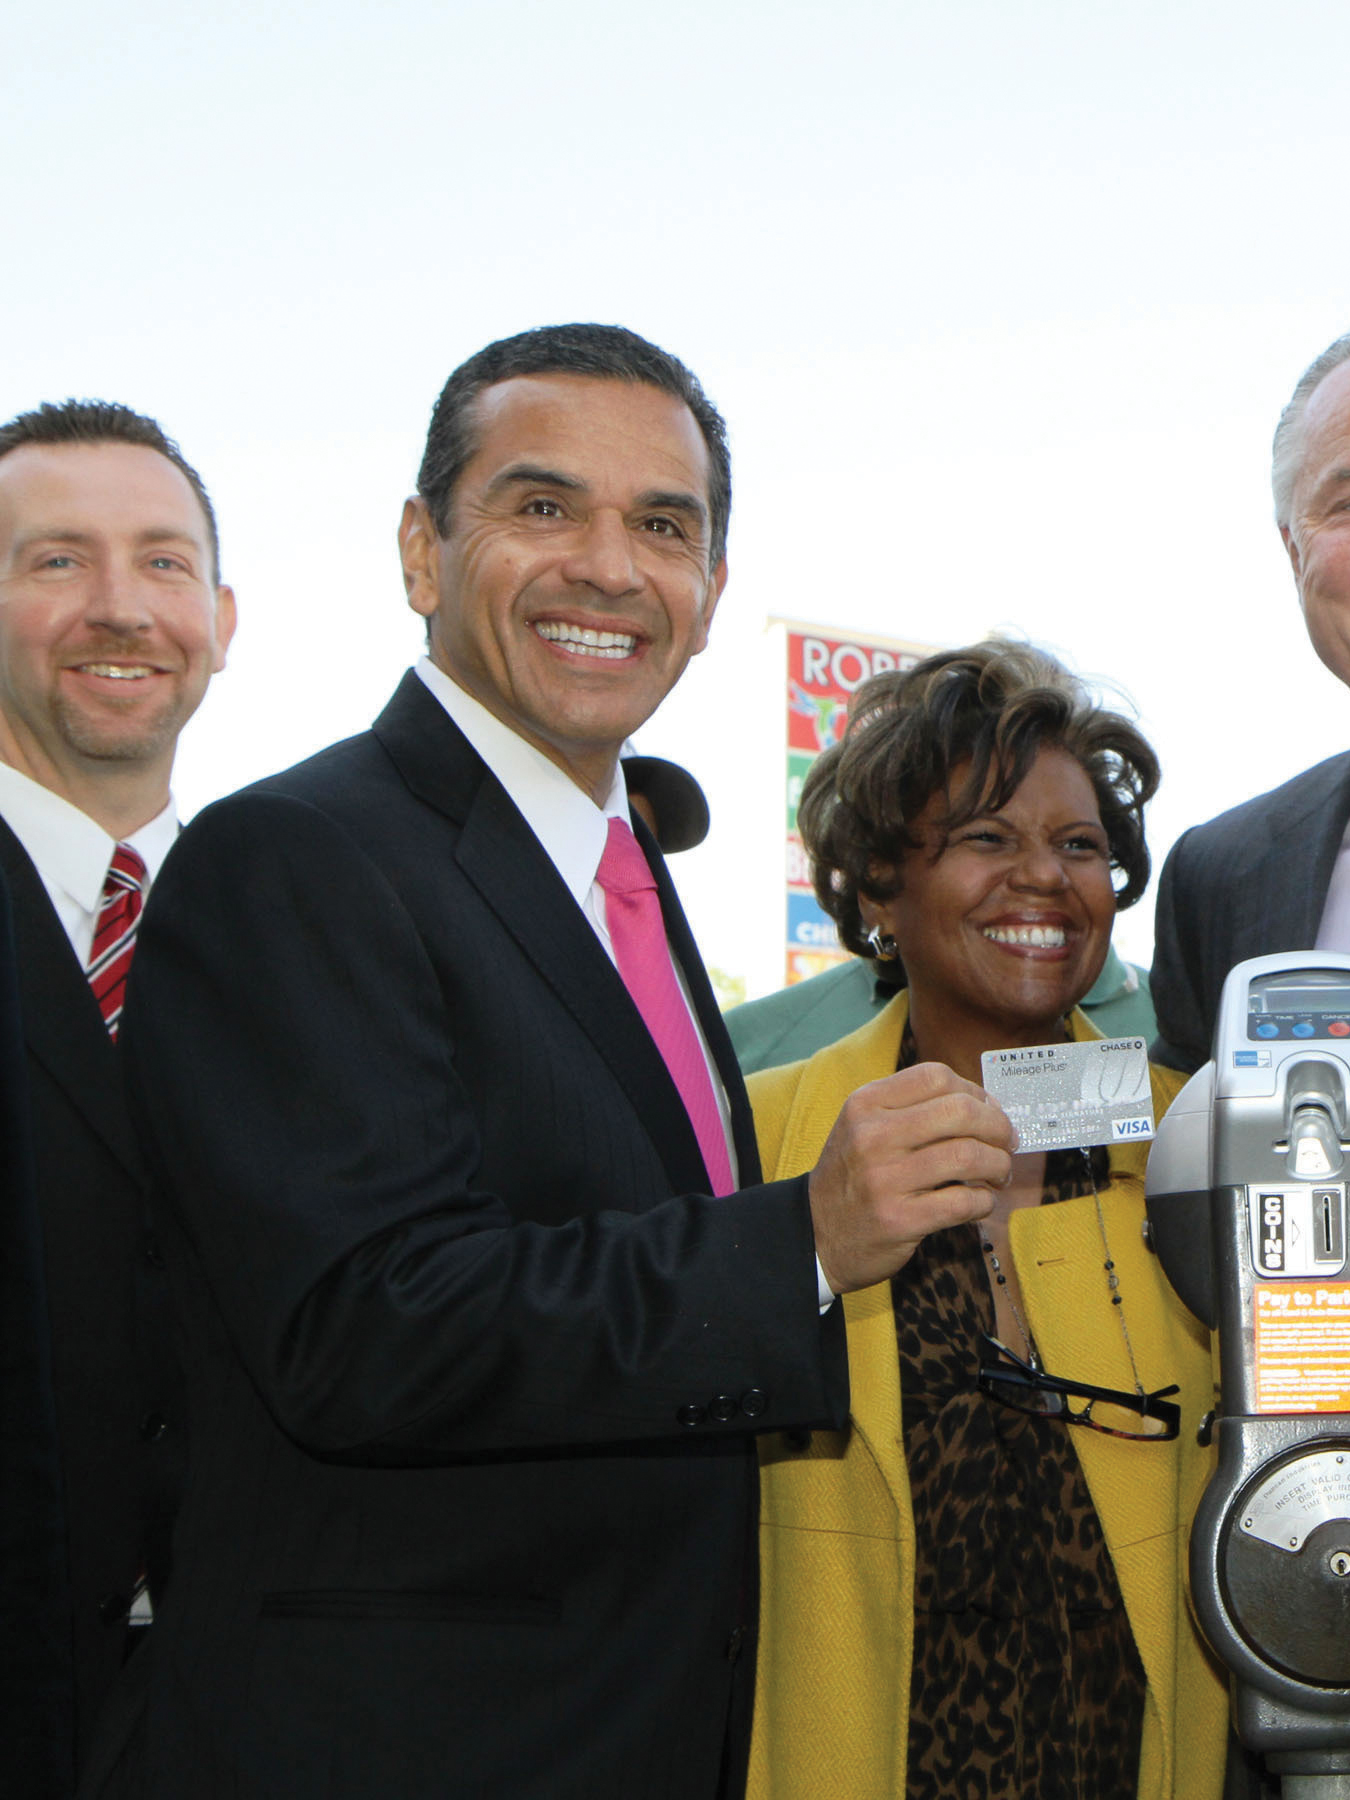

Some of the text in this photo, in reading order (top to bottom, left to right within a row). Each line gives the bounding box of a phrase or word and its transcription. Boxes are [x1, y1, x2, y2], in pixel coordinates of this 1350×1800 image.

[1101, 1042, 1132, 1052] CHASE
[1000, 1050, 1055, 1062] UNITED
[1001, 1066, 1041, 1077] Mileage
[1117, 1120, 1150, 1135] VISA
[1264, 1197, 1282, 1269] COINS
[1258, 1290, 1291, 1308] Pay
[1293, 1290, 1312, 1306] to
[1275, 1483, 1307, 1511] INSERT
[1311, 1473, 1341, 1485] VALID
[1298, 1485, 1333, 1503] DISPLAY
[1302, 1498, 1320, 1512] TIME
